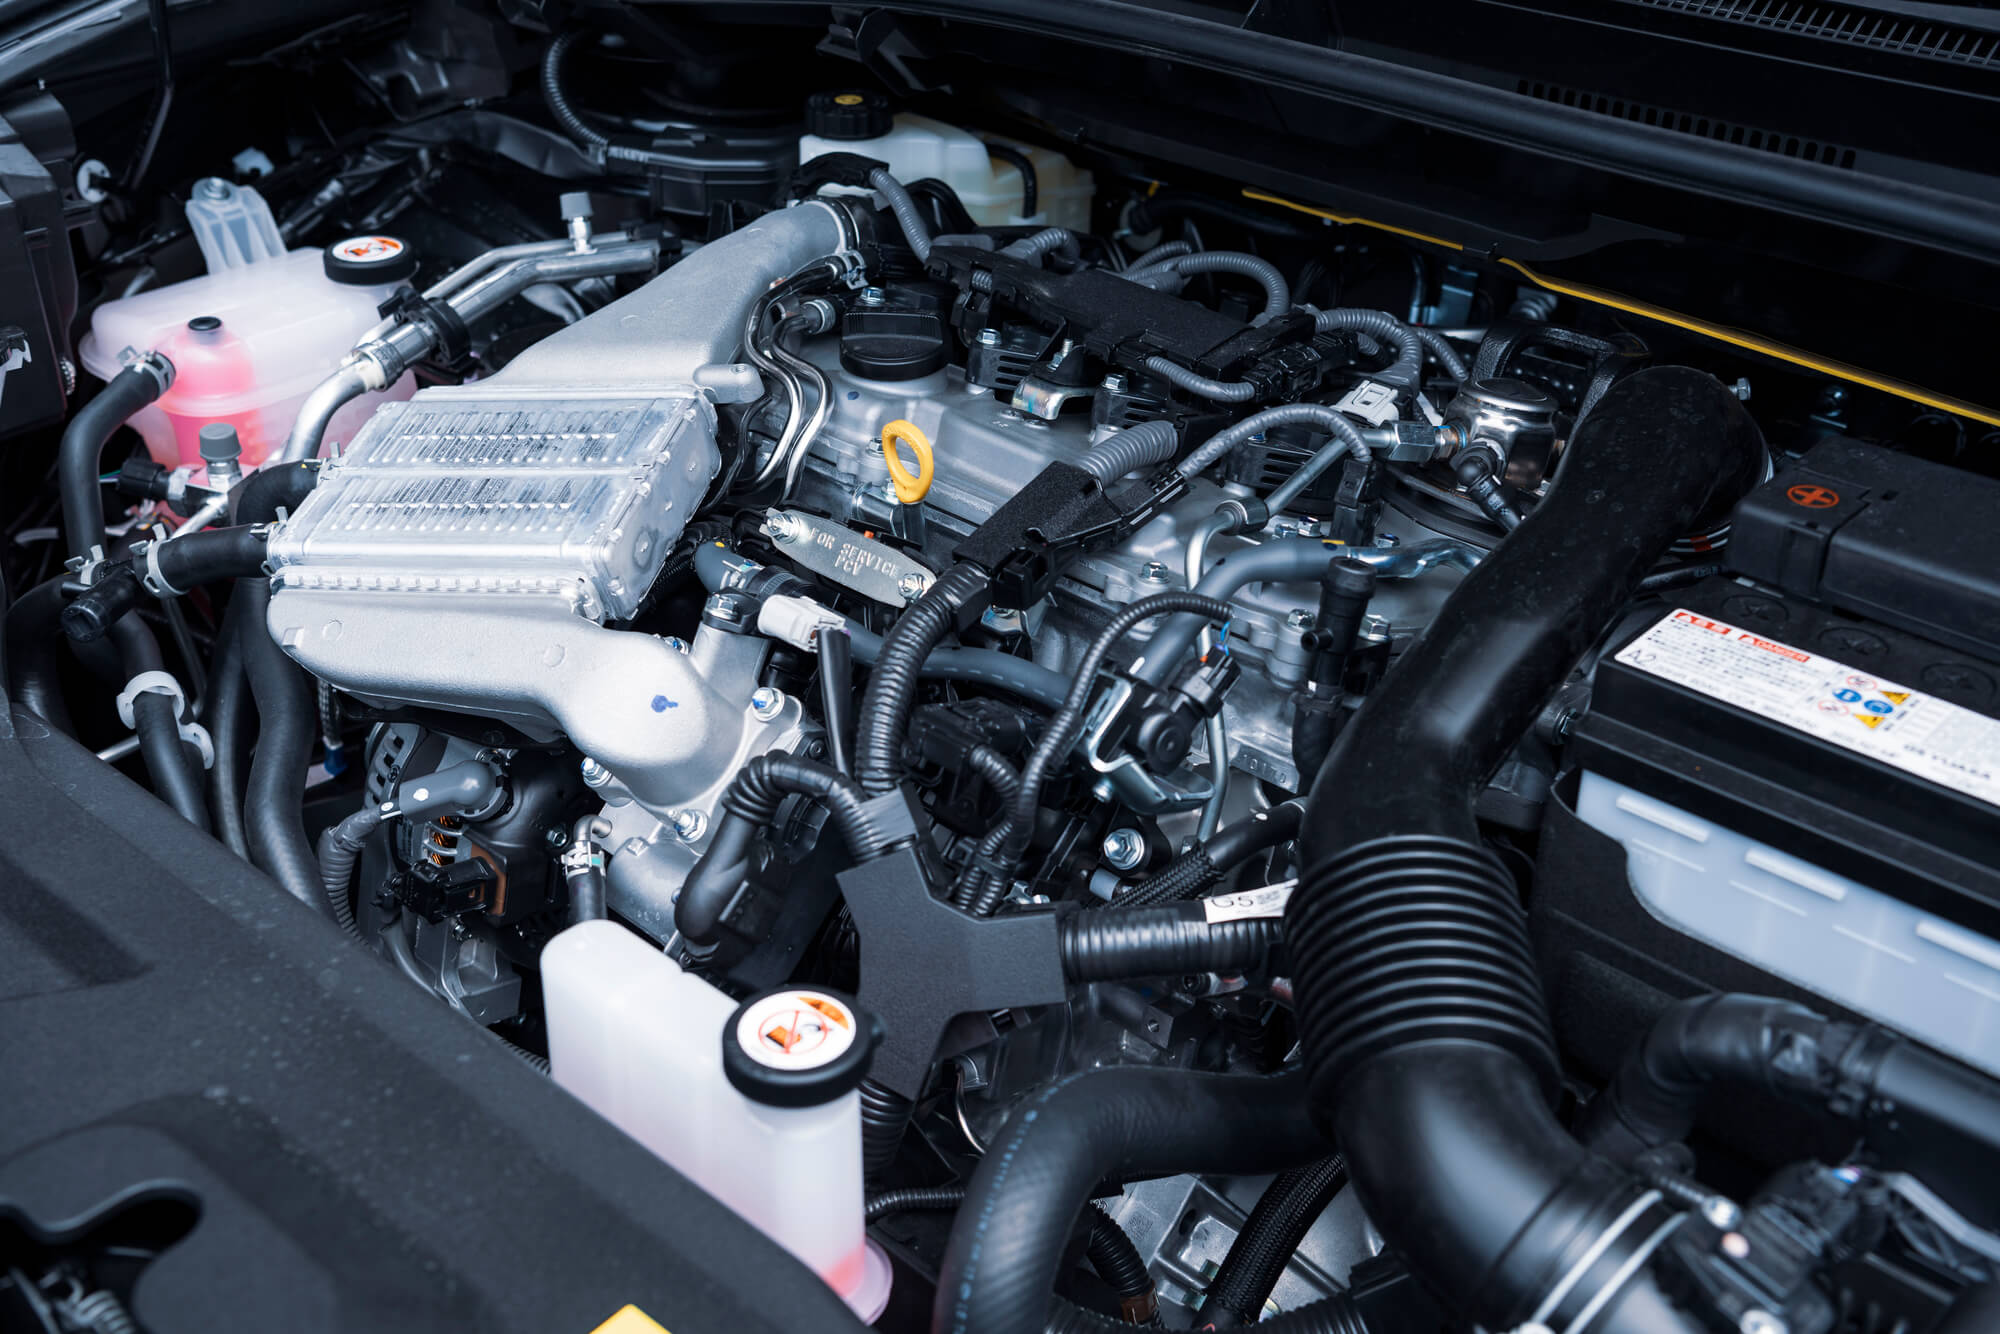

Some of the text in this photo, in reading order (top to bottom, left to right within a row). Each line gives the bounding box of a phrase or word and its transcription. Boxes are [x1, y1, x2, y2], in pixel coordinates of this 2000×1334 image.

[809, 527, 899, 578] FOR SERVICE
[834, 554, 865, 577] PCV
